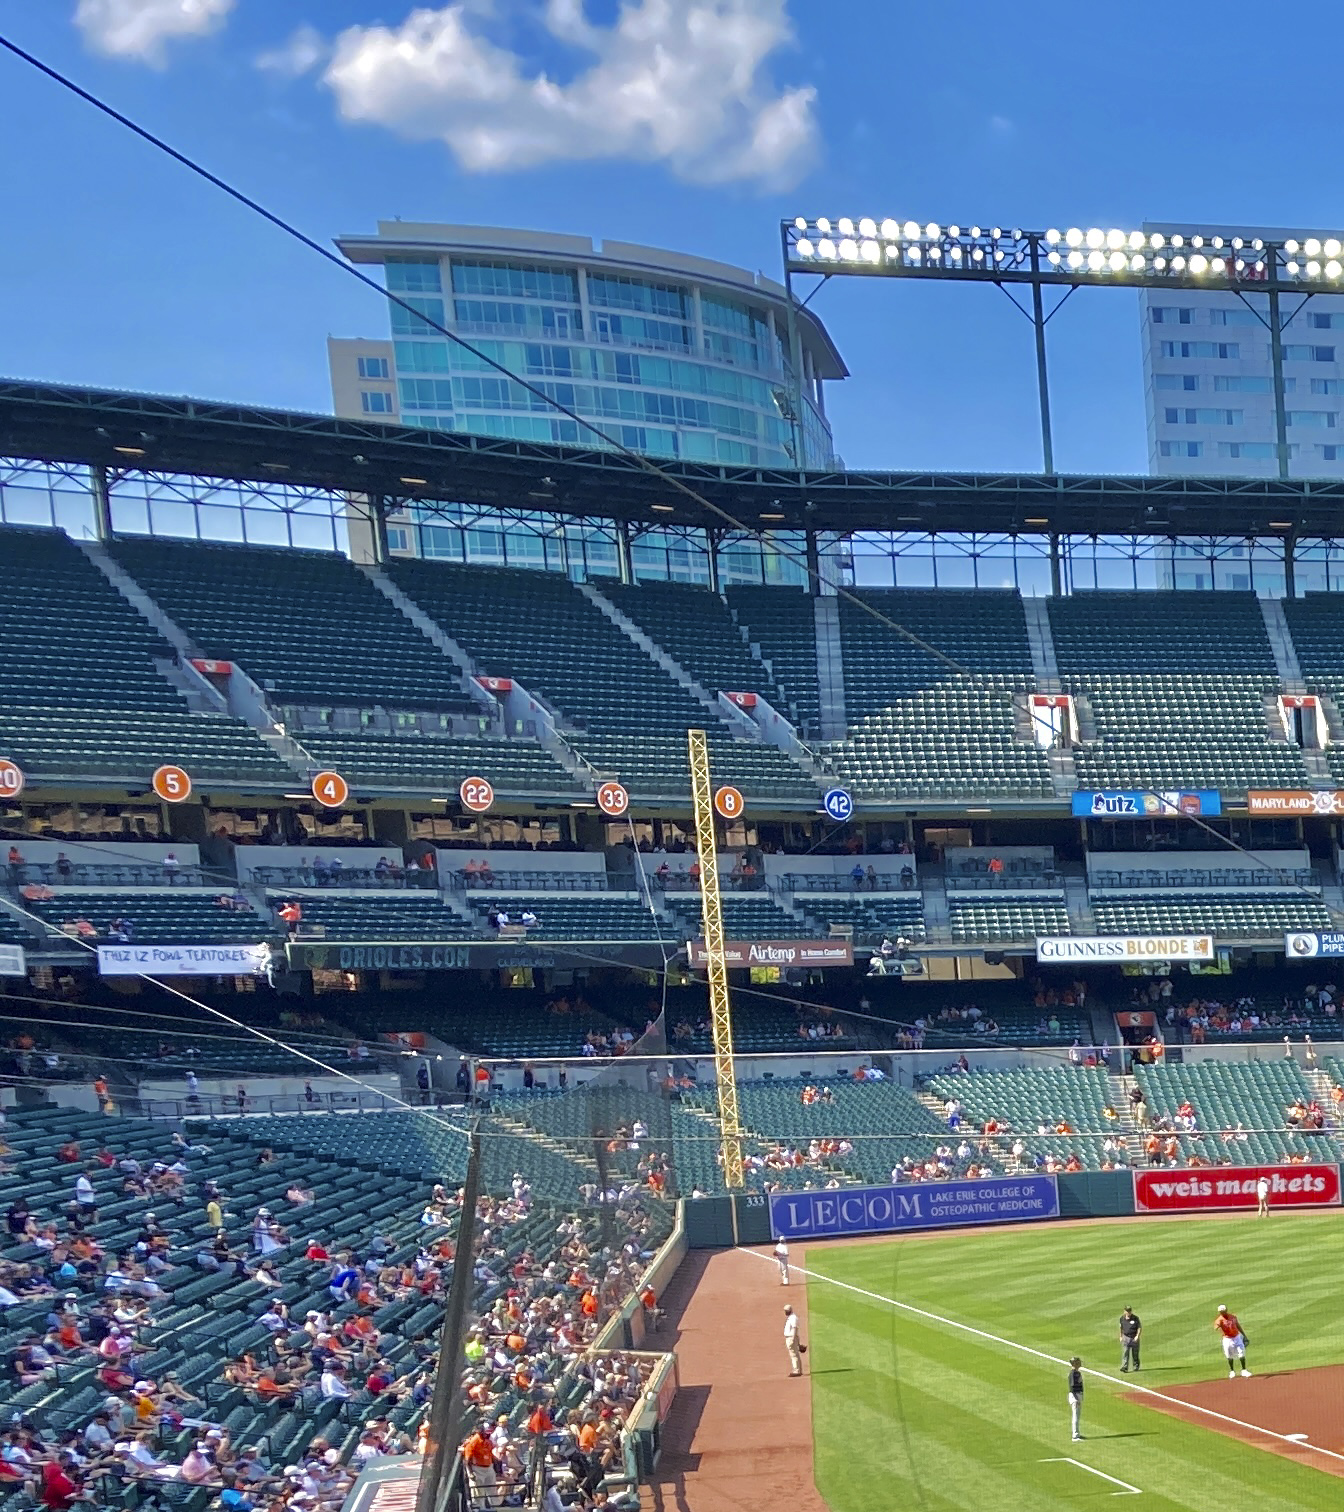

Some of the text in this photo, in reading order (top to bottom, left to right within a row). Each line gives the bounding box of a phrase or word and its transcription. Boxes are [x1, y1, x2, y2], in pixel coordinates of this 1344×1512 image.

[165, 774, 180, 793] 5
[323, 779, 336, 798] 4
[466, 785, 489, 802] 22
[603, 789, 625, 808] 33
[725, 794, 735, 810] 8
[828, 796, 849, 813] 42
[1251, 798, 1310, 809] MARYLAND
[749, 944, 796, 963] Airtemp
[1040, 939, 1188, 957] GUINNESS BLONDE
[1322, 943, 1344, 952] PIPE
[339, 946, 470, 968] ORIOLES.COM
[929, 1185, 1036, 1203] LAKE ERIE COLLEGE OF
[1150, 1177, 1212, 1198] weis
[746, 1196, 764, 1207] 333
[930, 1198, 1043, 1217] OSTEOPATHIC MEDICINE
